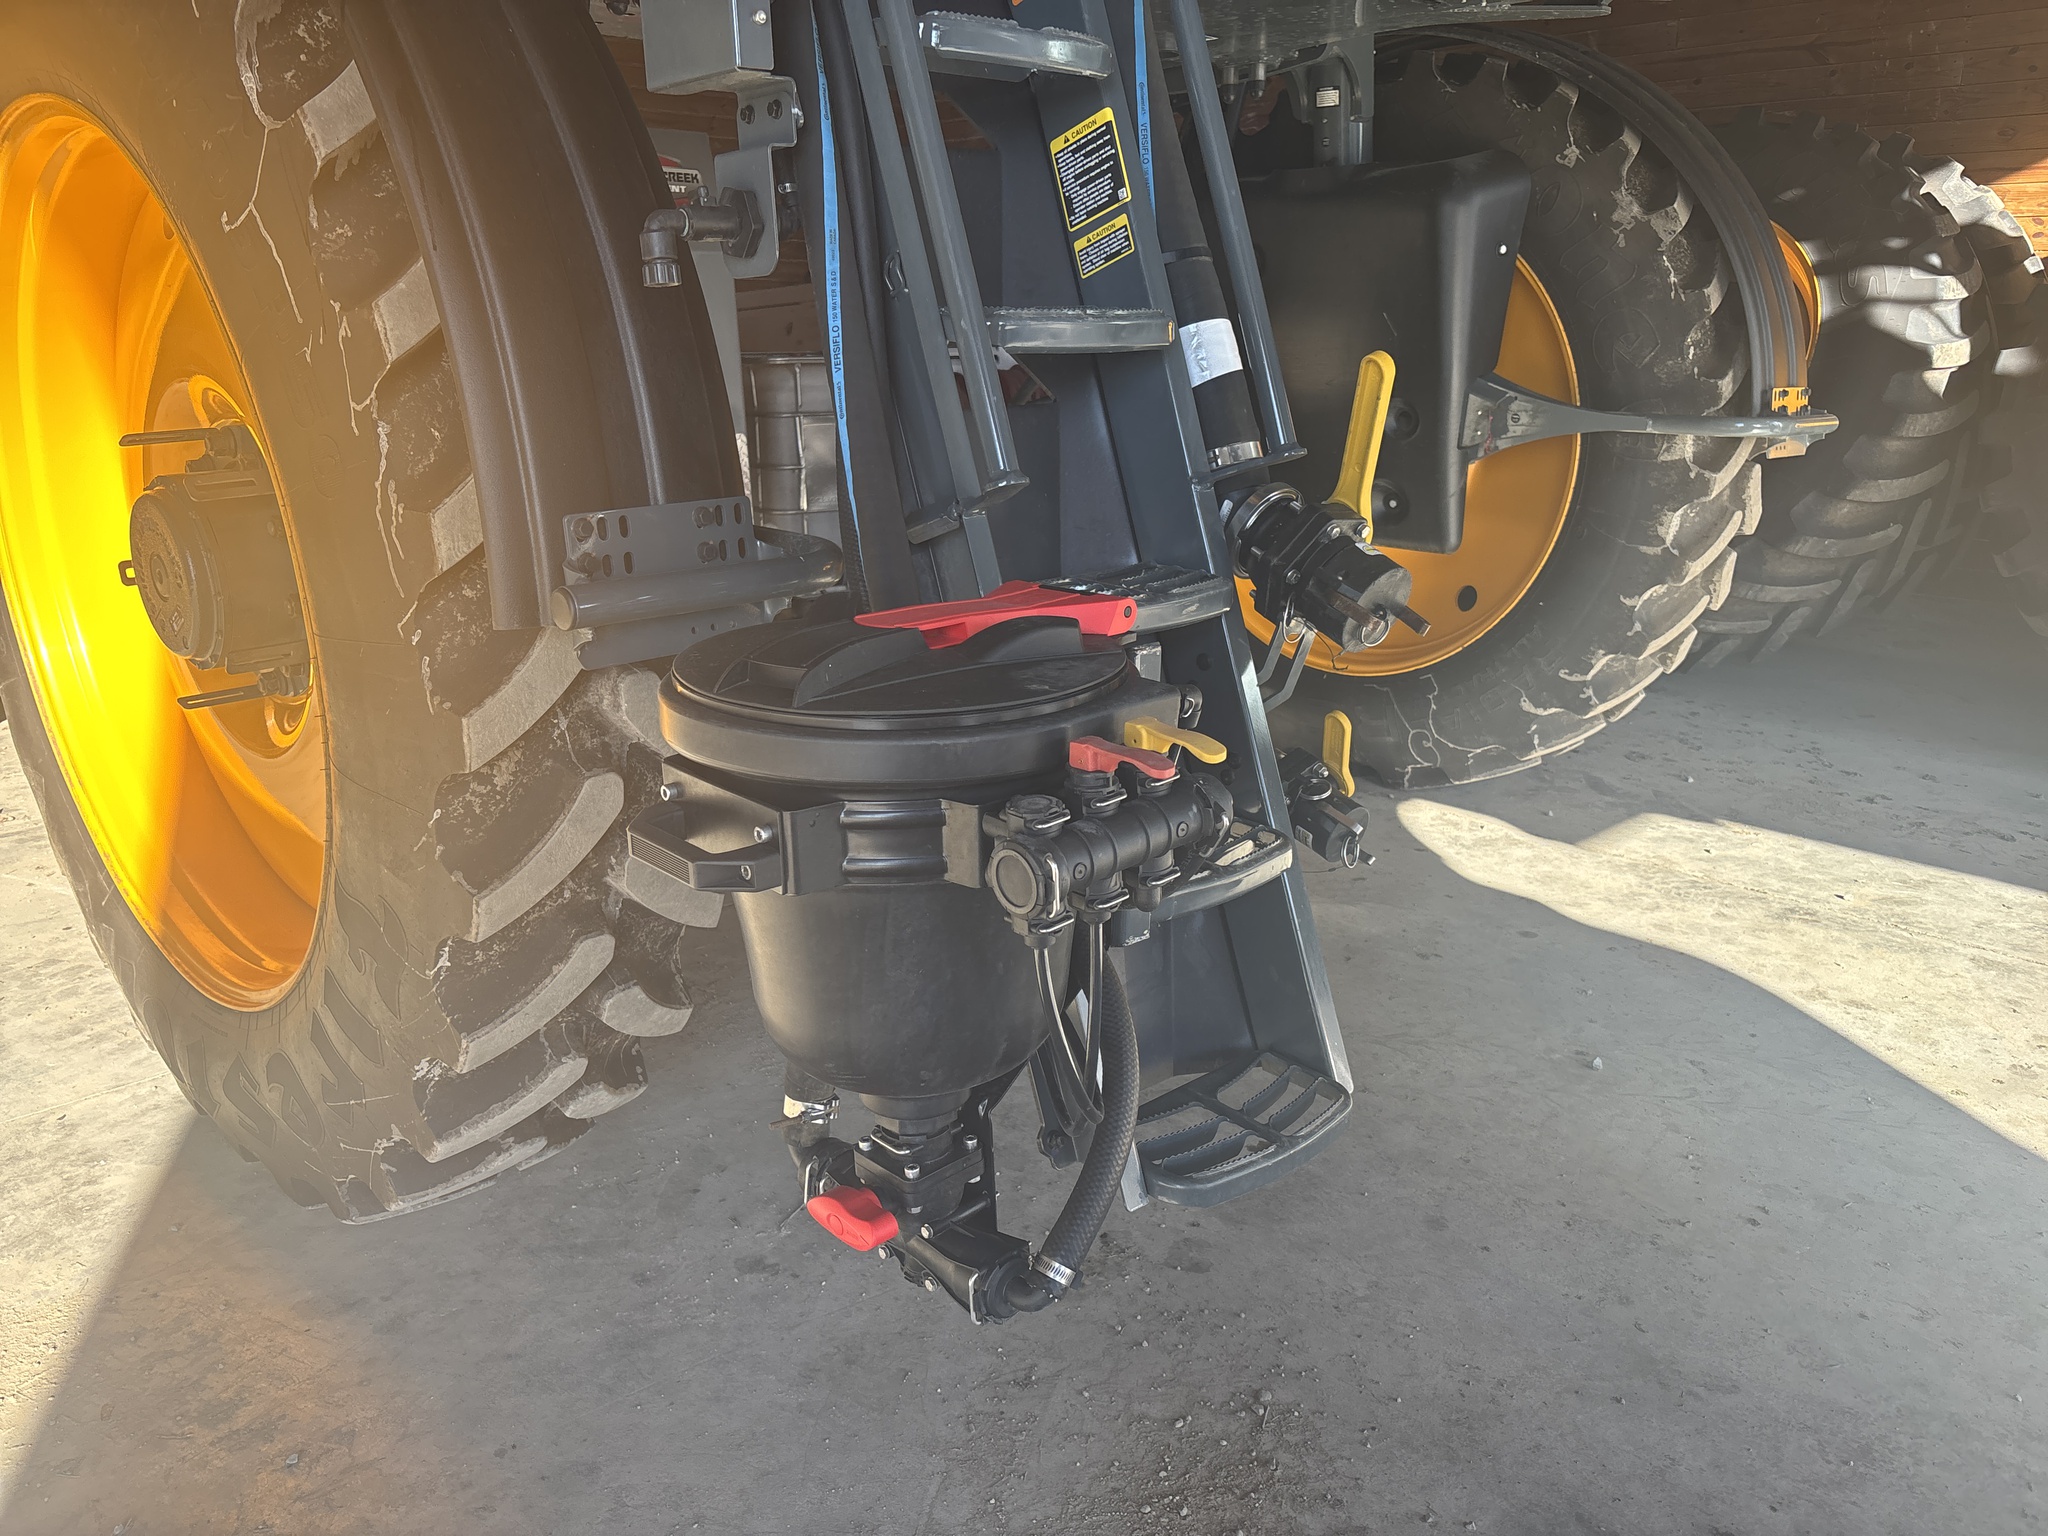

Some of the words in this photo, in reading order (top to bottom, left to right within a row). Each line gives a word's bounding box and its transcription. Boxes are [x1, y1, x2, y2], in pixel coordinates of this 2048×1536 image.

[1071, 118, 1097, 139] CAUTION
[1141, 122, 1149, 165] VERSIFLO
[1092, 222, 1116, 241] CAUTION
[831, 325, 841, 373] VERSIFLO
